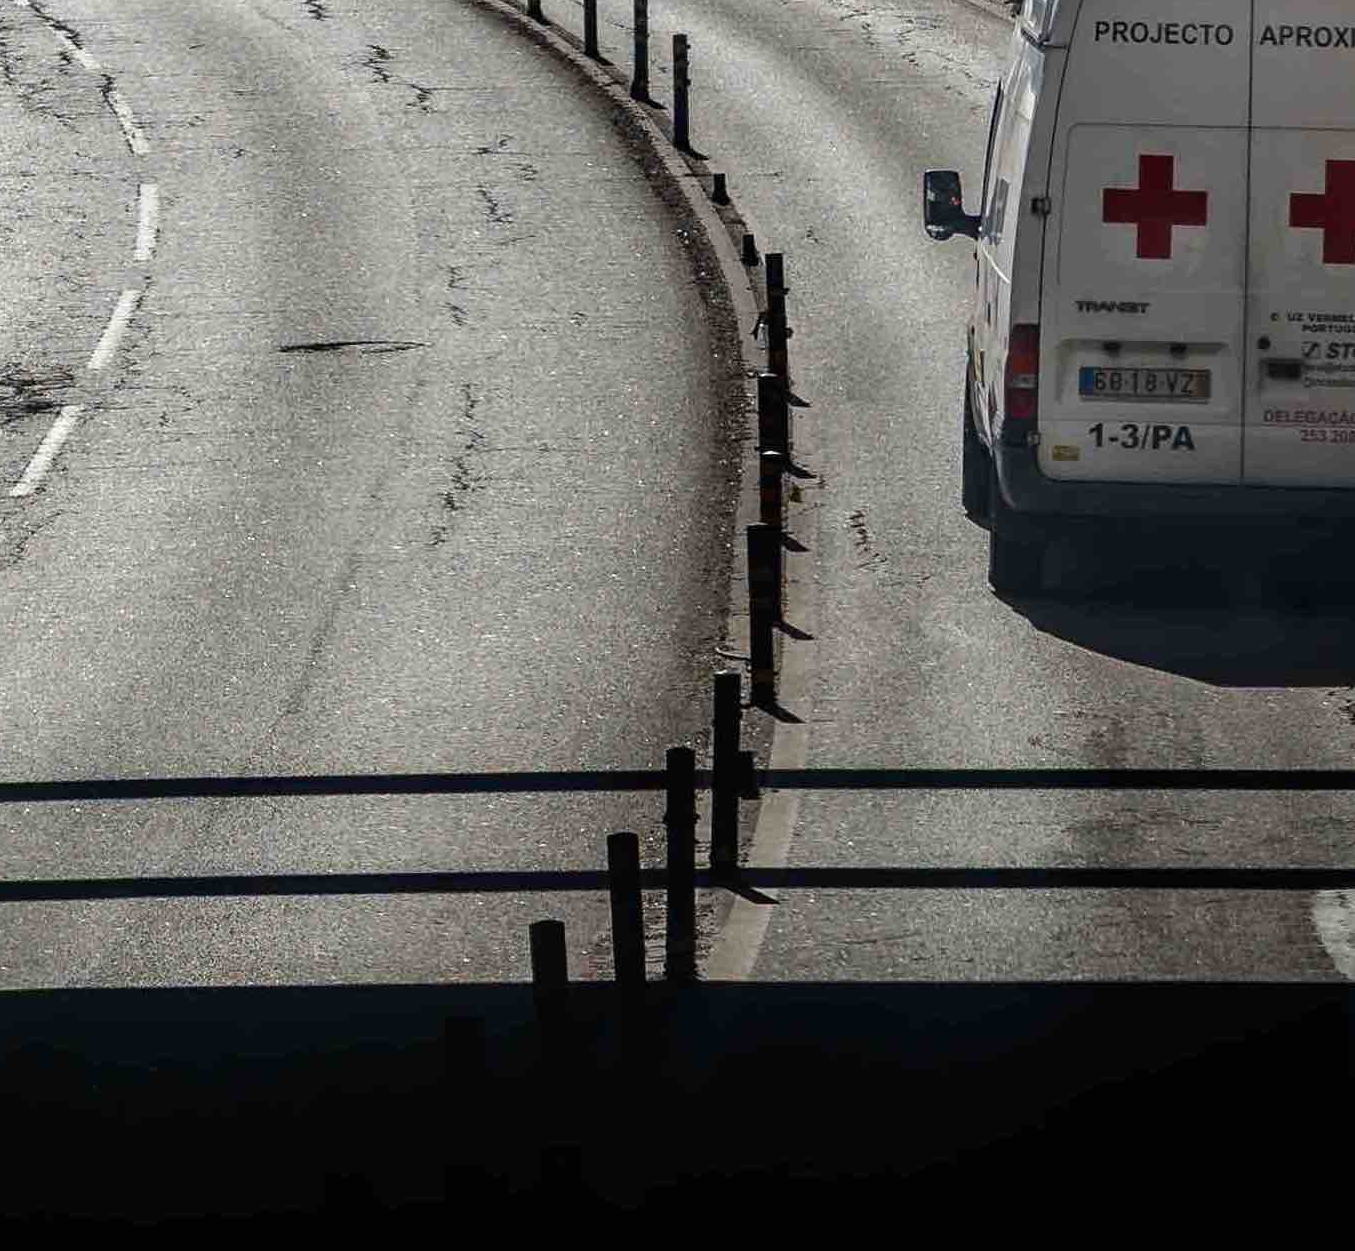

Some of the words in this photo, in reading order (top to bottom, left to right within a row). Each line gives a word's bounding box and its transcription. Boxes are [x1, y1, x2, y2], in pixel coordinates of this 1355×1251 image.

[1095, 21, 1234, 46] PROJECTO
[1075, 300, 1150, 314] TRANSIT
[1087, 422, 1195, 451] 1-3/PA
